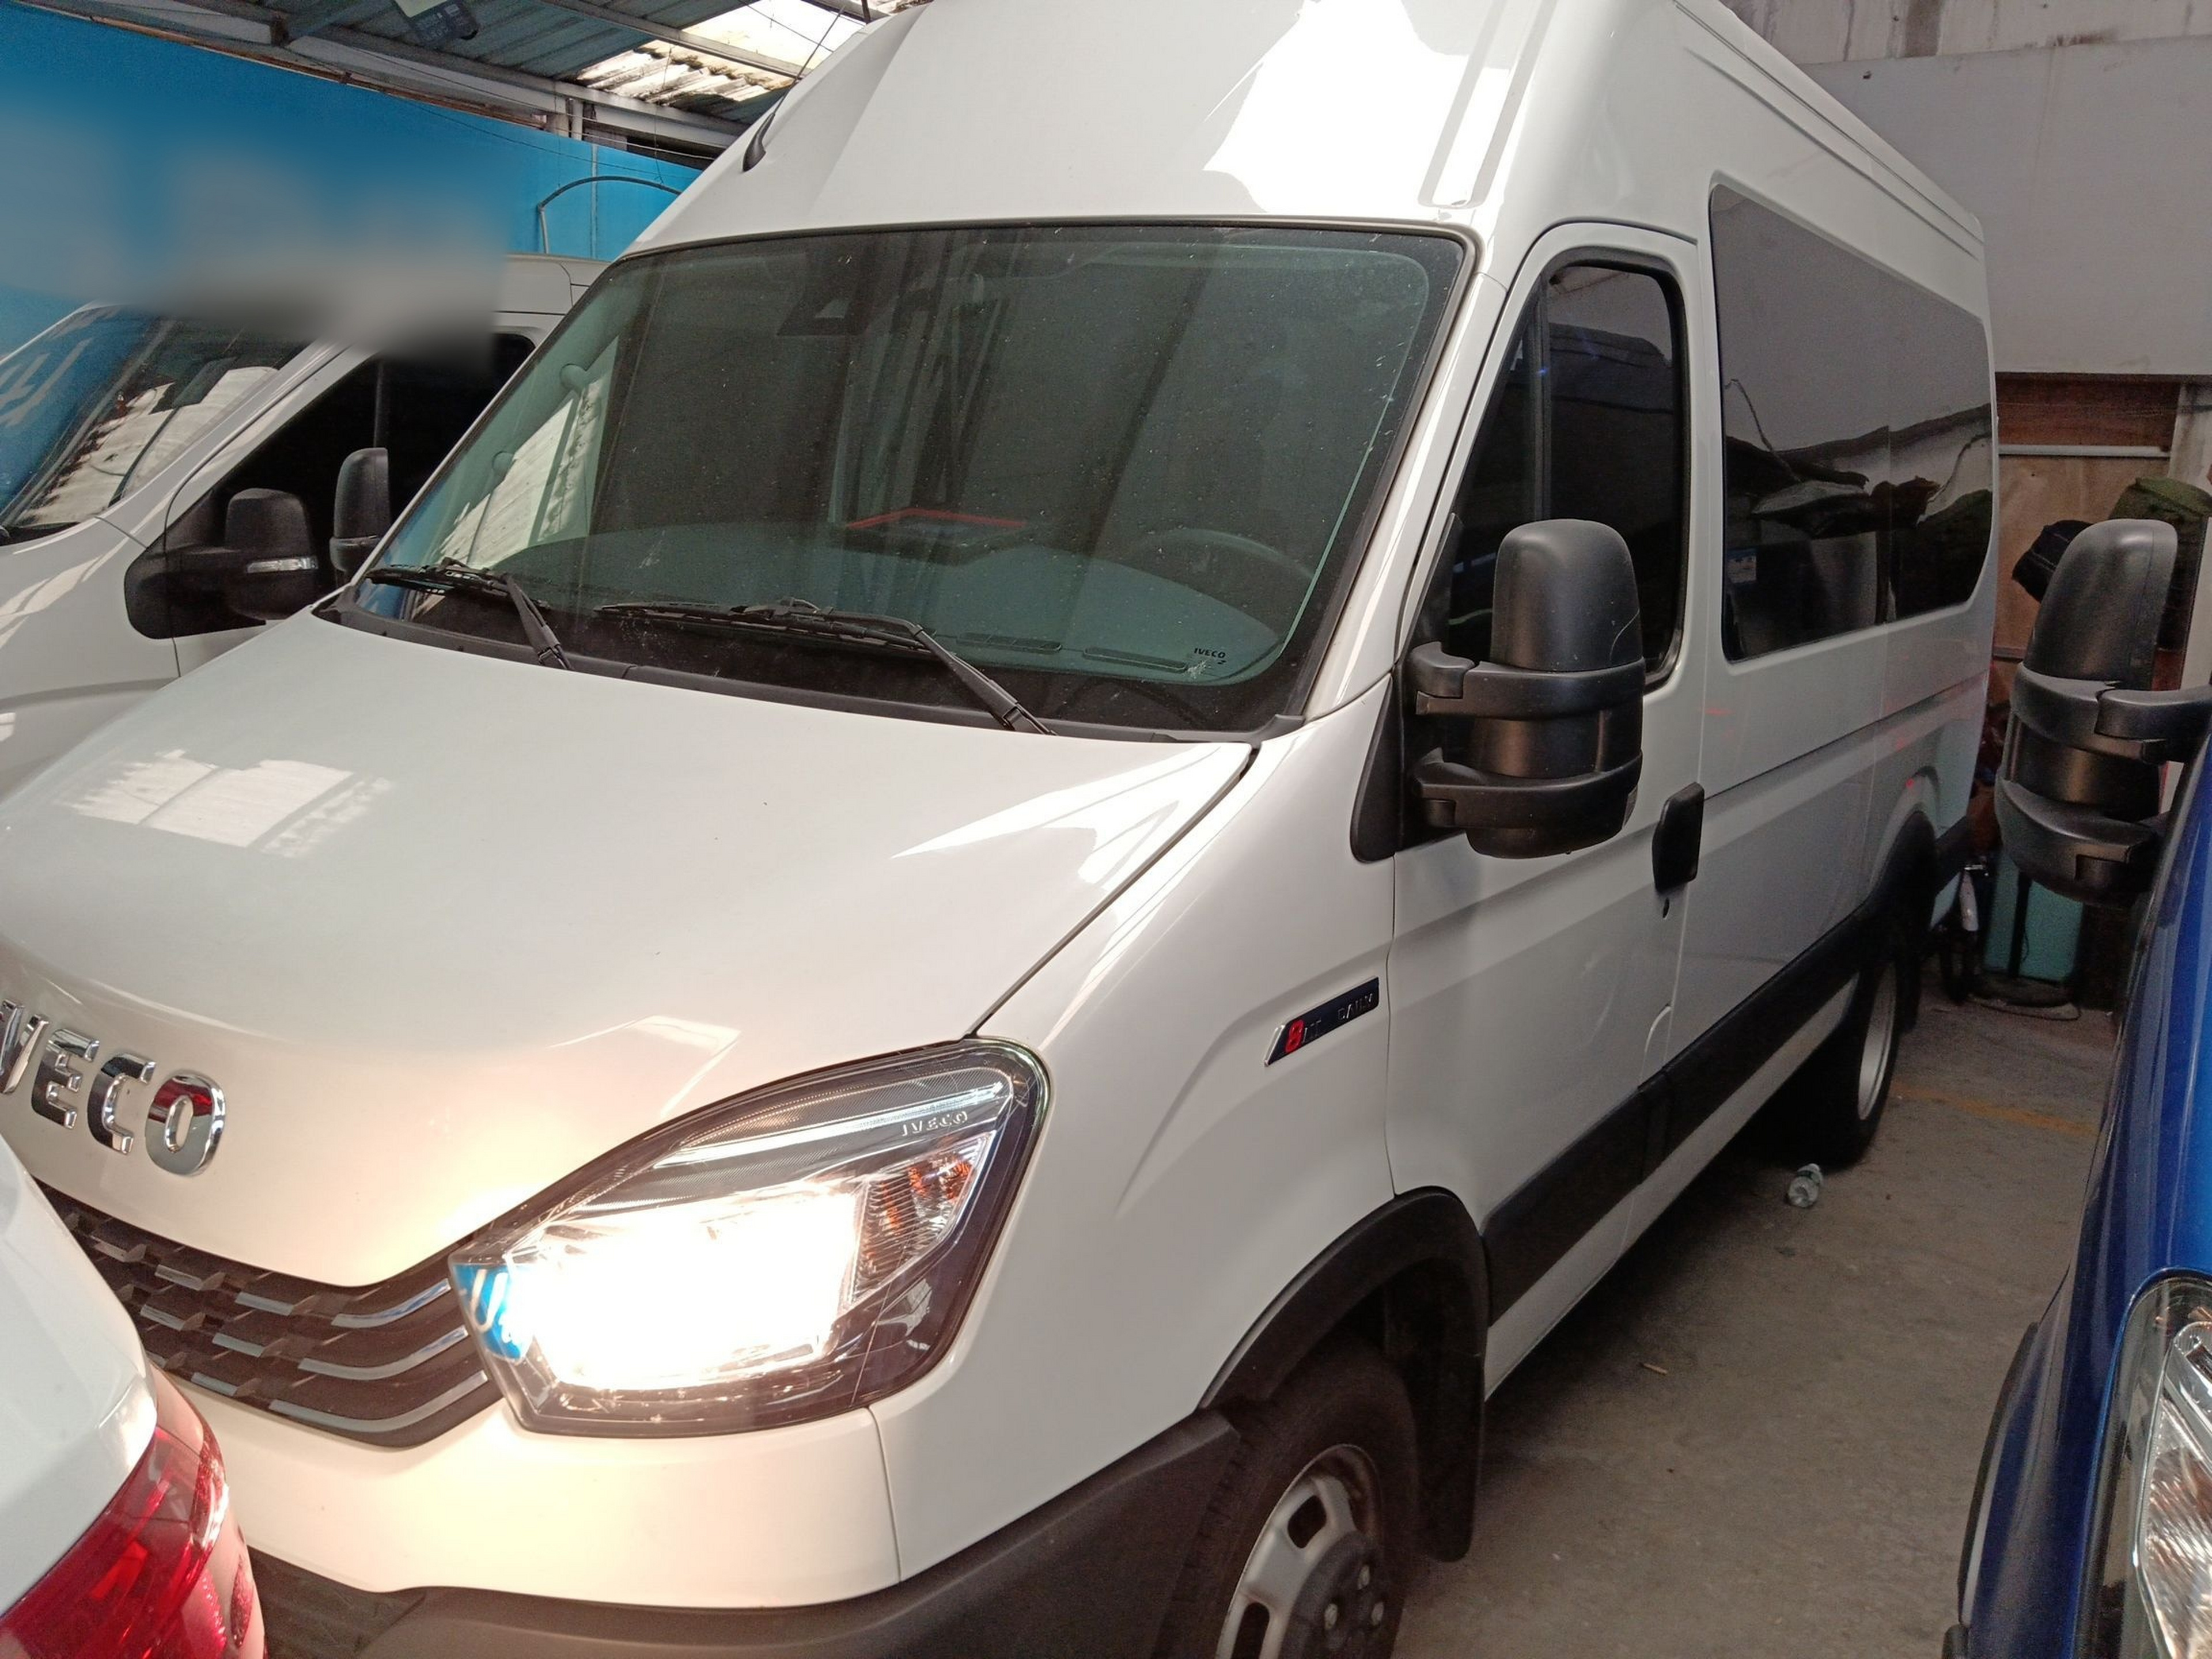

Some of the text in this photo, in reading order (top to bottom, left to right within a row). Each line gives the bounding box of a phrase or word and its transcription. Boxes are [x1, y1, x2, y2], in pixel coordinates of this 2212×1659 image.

[1194, 647, 1226, 658] IVECO
[1337, 993, 1373, 1020] DAILY
[900, 1111, 968, 1137] IVECO
